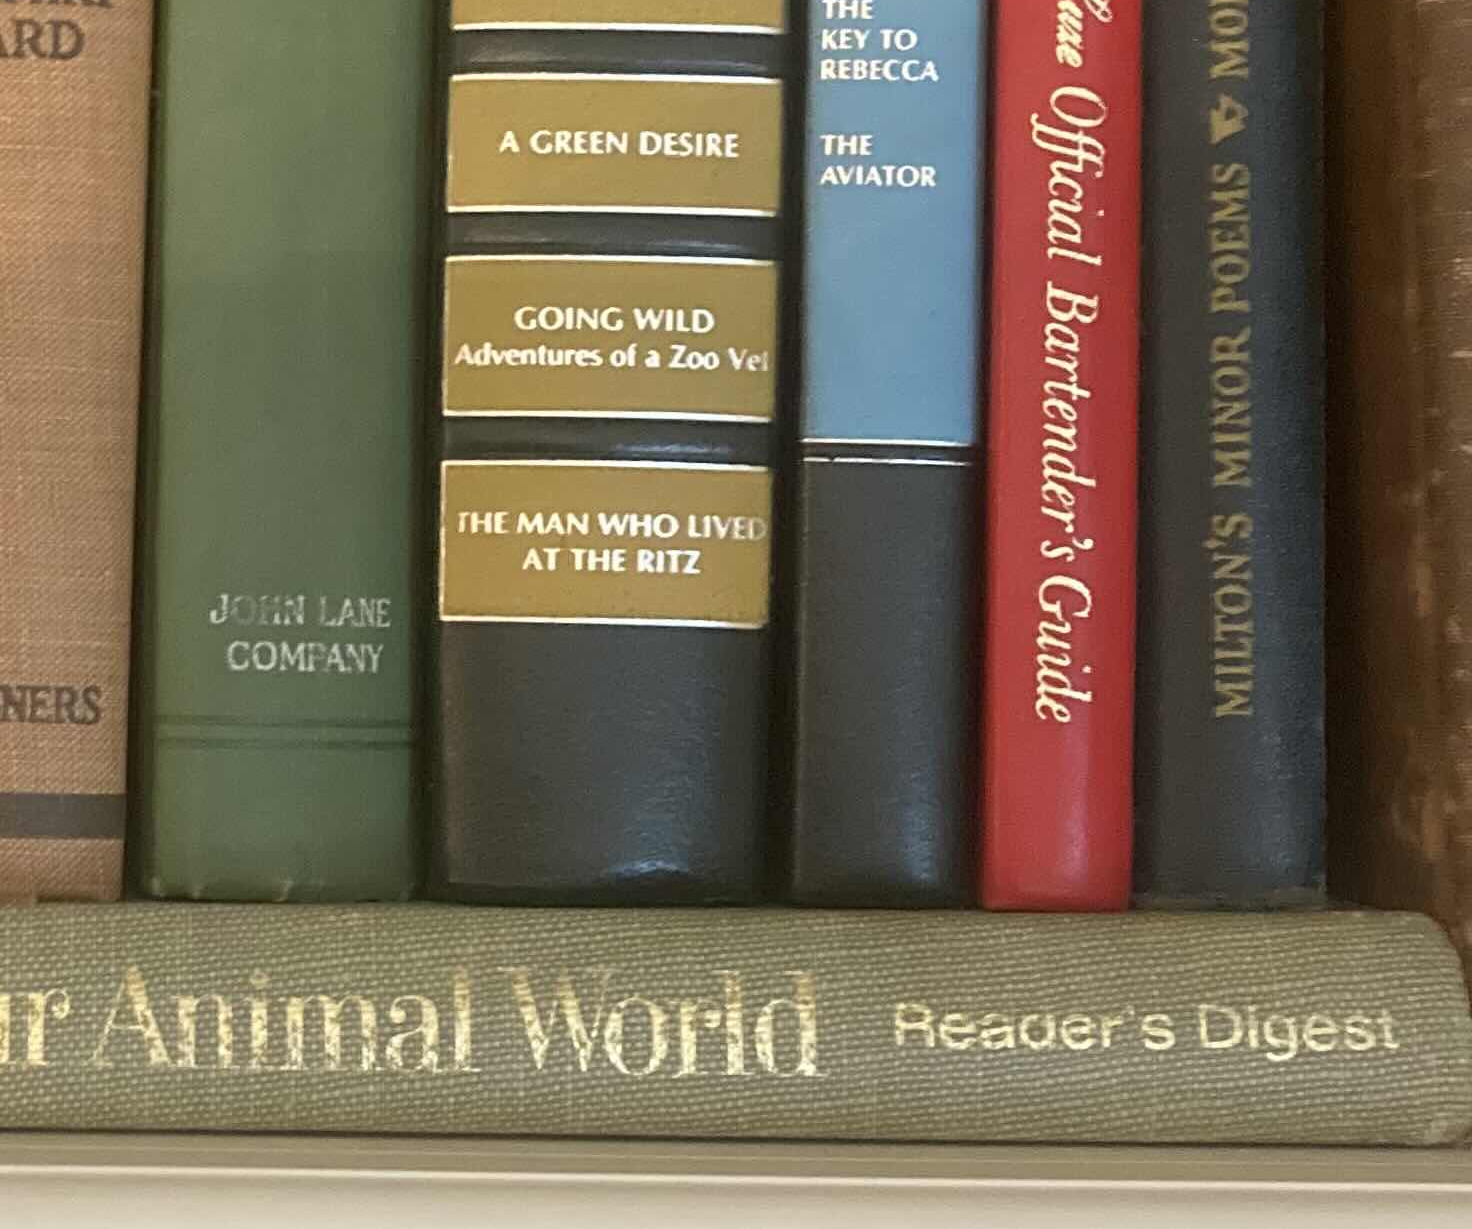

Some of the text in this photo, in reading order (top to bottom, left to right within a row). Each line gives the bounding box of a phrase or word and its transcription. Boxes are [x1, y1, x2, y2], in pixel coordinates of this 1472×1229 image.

[820, 28, 919, 51] KEY TO
[819, 58, 940, 82] REBECCA
[498, 129, 741, 159] A GREEN DESIRE
[819, 133, 874, 156] THE
[819, 164, 937, 188] AVIATOR
[1029, 85, 1108, 268] Official
[1206, 162, 1252, 315] POEMS
[513, 305, 716, 334] GOING WILD
[454, 341, 604, 368] Adventures
[610, 343, 639, 368] of
[644, 348, 661, 368] a
[667, 344, 721, 371] Zoo
[1039, 280, 1100, 563] Bartender's
[1208, 326, 1253, 488] MINOR
[457, 510, 768, 541] THE MAN WHO LIVED
[521, 547, 702, 575] AT THE RITZ
[208, 591, 392, 629] JOHN LANE
[1201, 513, 1256, 719] MILTON'S
[226, 639, 385, 674] COMPANY
[1033, 573, 1094, 725] Guide
[81, 966, 484, 1073] Animal
[496, 967, 827, 1078] World
[892, 1000, 1401, 1064] Reader's Digest
